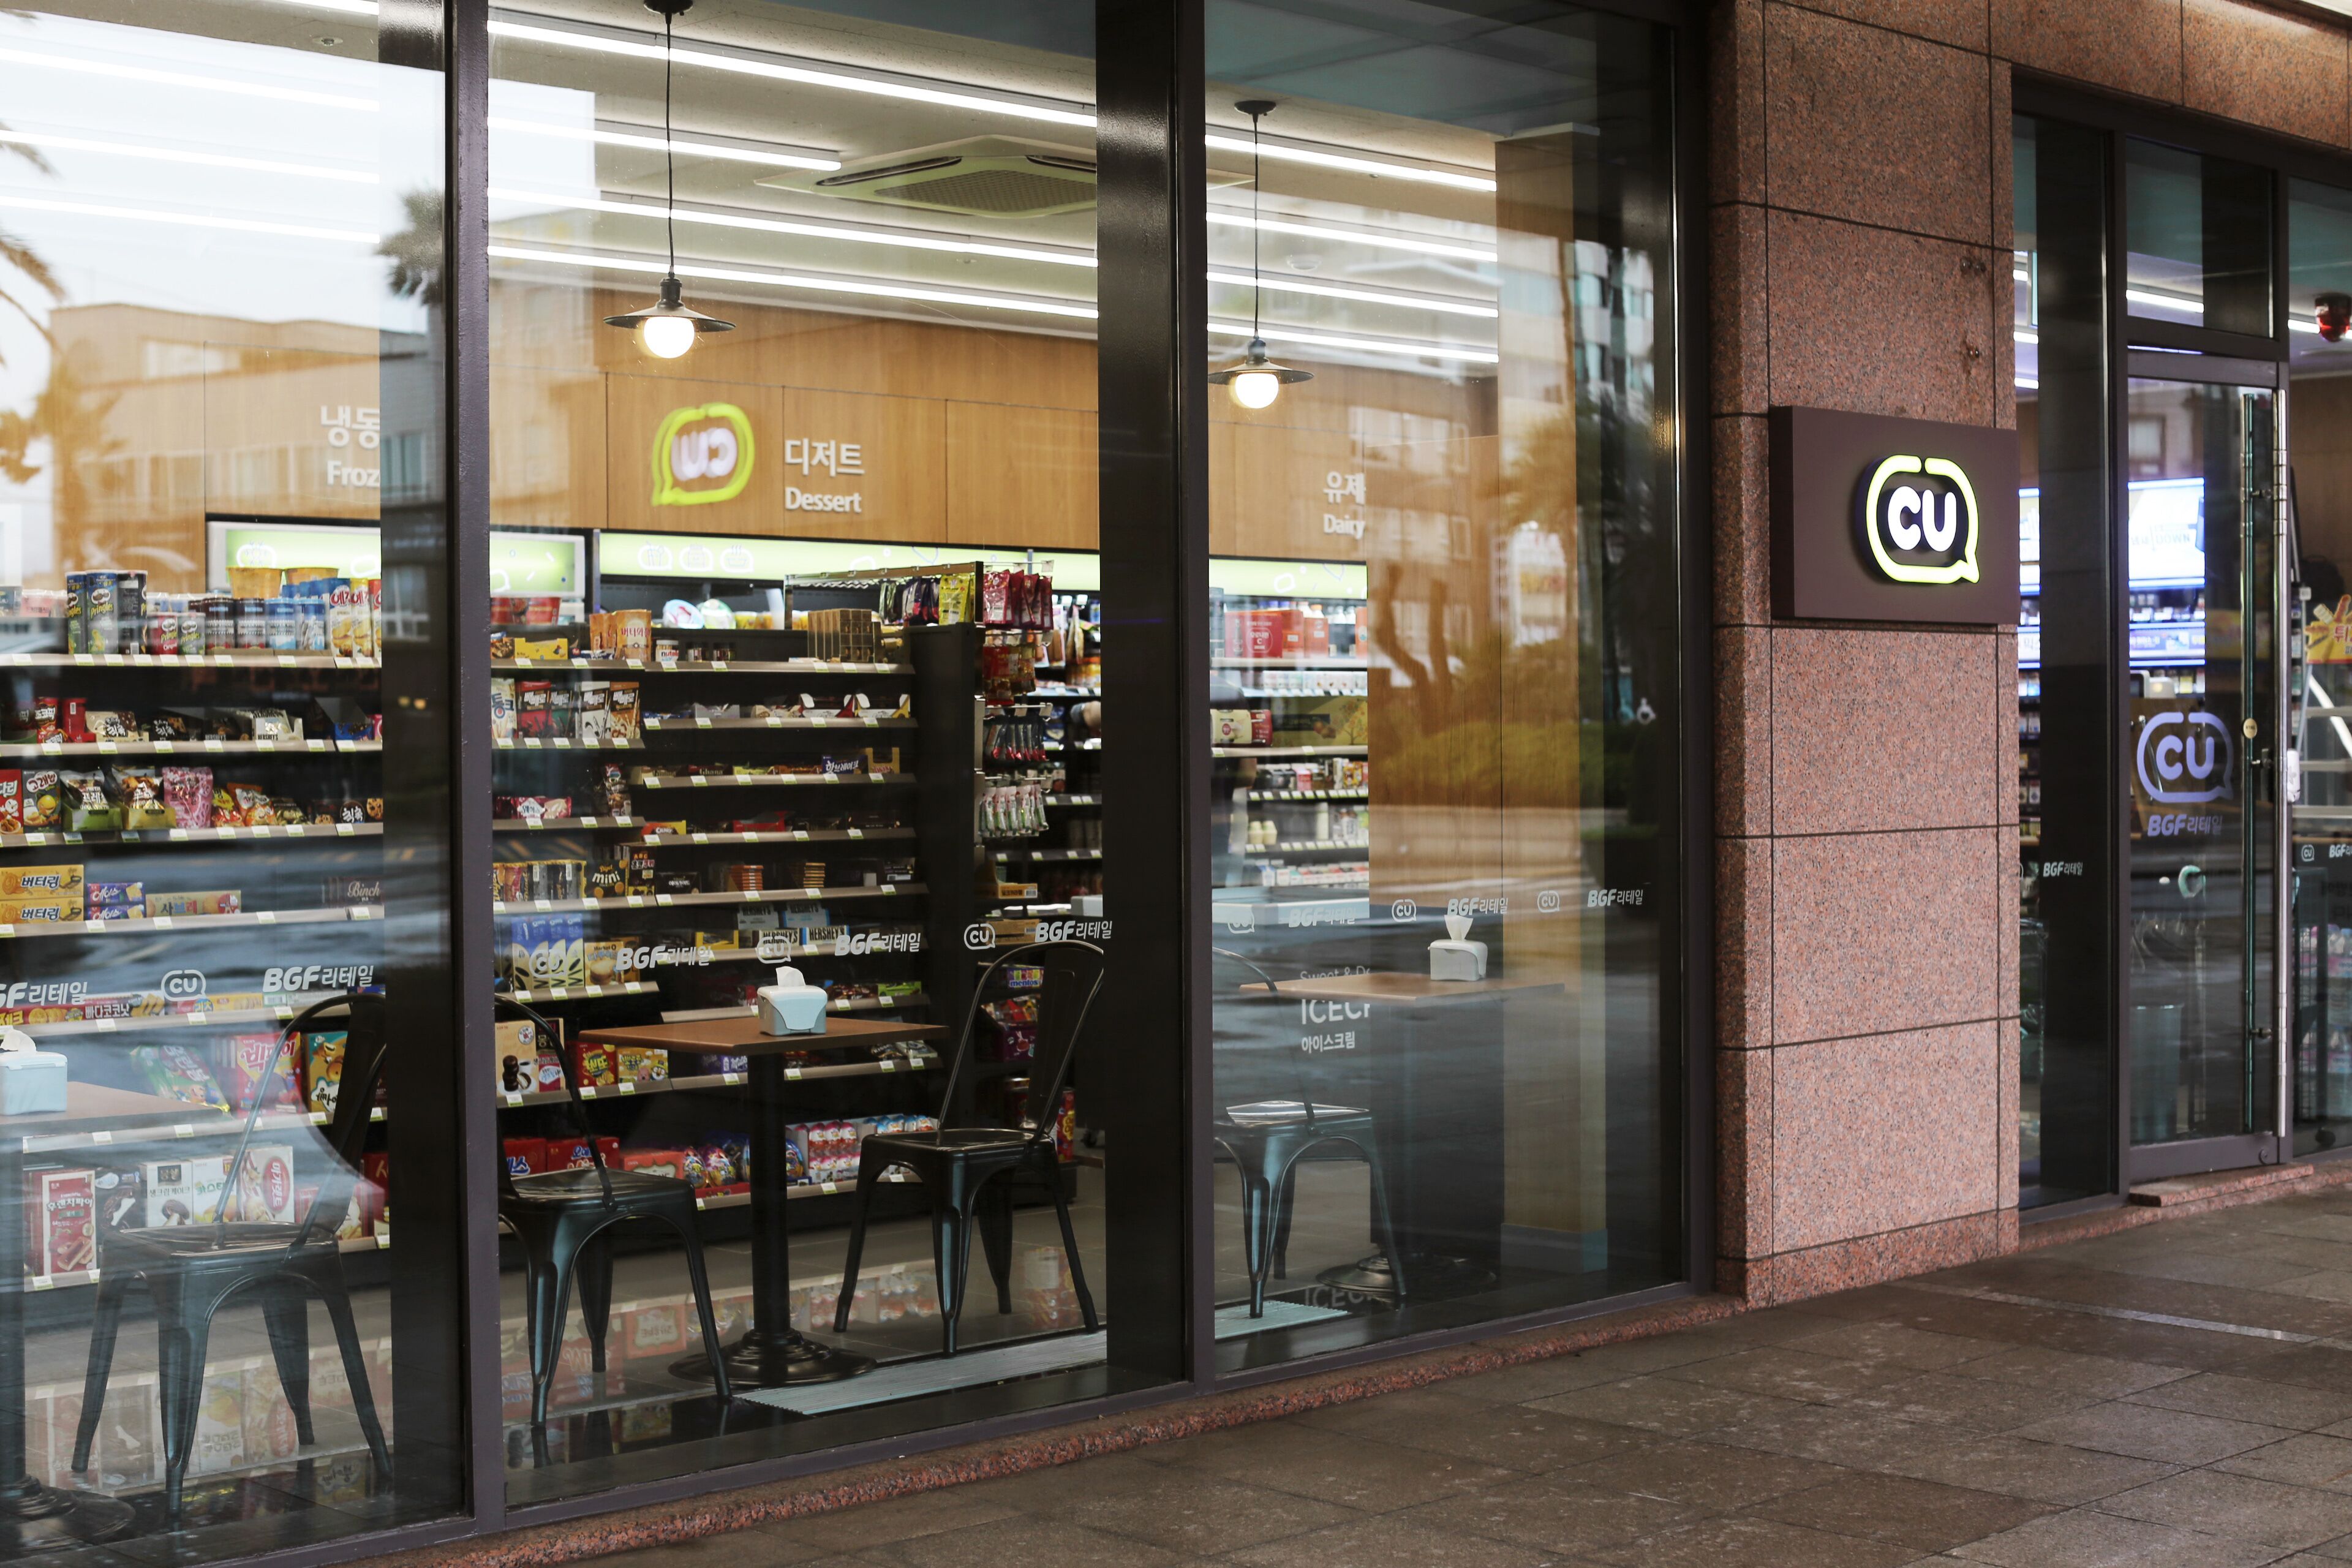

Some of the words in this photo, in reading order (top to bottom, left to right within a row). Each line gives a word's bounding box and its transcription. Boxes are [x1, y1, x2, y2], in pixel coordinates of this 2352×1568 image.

[321, 405, 380, 449] 냉동
[785, 437, 865, 477] 디저트
[327, 460, 380, 487] Froz
[785, 487, 862, 513] Dessert
[1324, 513, 1365, 540] Dairy
[1887, 485, 1957, 552] CU
[91, 602, 114, 618] Pringles
[181, 631, 200, 643] Pringles
[2156, 734, 2215, 780] CU
[28, 773, 57, 791] 고래밥
[2147, 814, 2223, 837] BGF리테일
[592, 871, 620, 885] mini
[2043, 861, 2083, 878] BGF리테일
[21, 875, 60, 890] 버터링
[347, 881, 380, 897] Binch
[160, 900, 197, 915] 사브레
[1447, 897, 1508, 916] BGF리테일
[1587, 889, 1643, 908] BGF리테일
[21, 907, 60, 922] 버터링
[1035, 921, 1112, 943] BGF리테일
[834, 932, 921, 956] BGF리테일
[616, 945, 711, 970] BGF리테일
[263, 965, 374, 992] BGF리테일
[85, 1003, 130, 1020] 빠다코코낫
[1302, 1031, 1355, 1054] 아이스크림
[272, 1161, 283, 1207] 마가렛트
